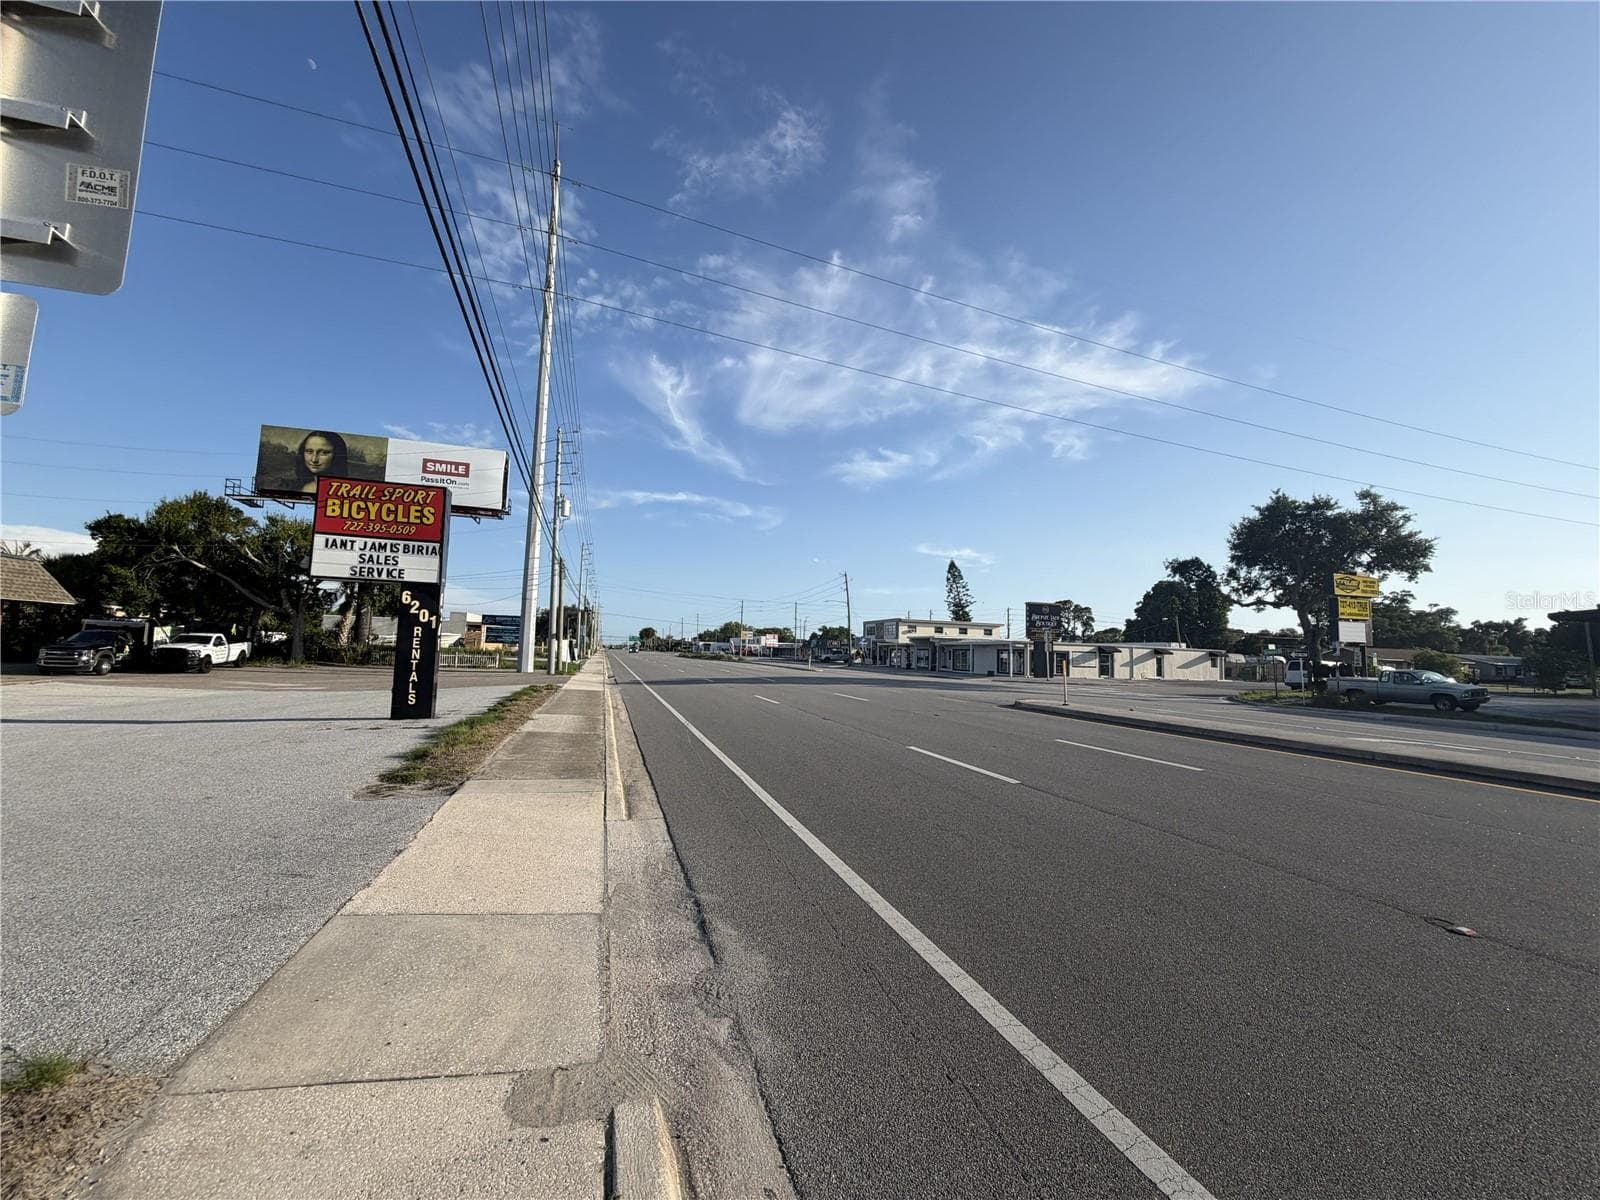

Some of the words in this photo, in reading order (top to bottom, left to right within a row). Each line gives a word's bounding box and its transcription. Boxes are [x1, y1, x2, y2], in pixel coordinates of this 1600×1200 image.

[81, 169, 117, 181] F.D.O.T.
[426, 462, 466, 475] SMILE
[328, 482, 377, 499] TRAIL
[381, 487, 437, 504] SPORT
[325, 498, 436, 524] BICYCLES
[343, 521, 417, 535] 727-395-0509
[324, 537, 357, 551] IANT
[358, 553, 400, 566] SALES
[349, 566, 405, 579] SERVICE
[401, 590, 437, 629] 6201
[407, 626, 422, 705] RENTALS
